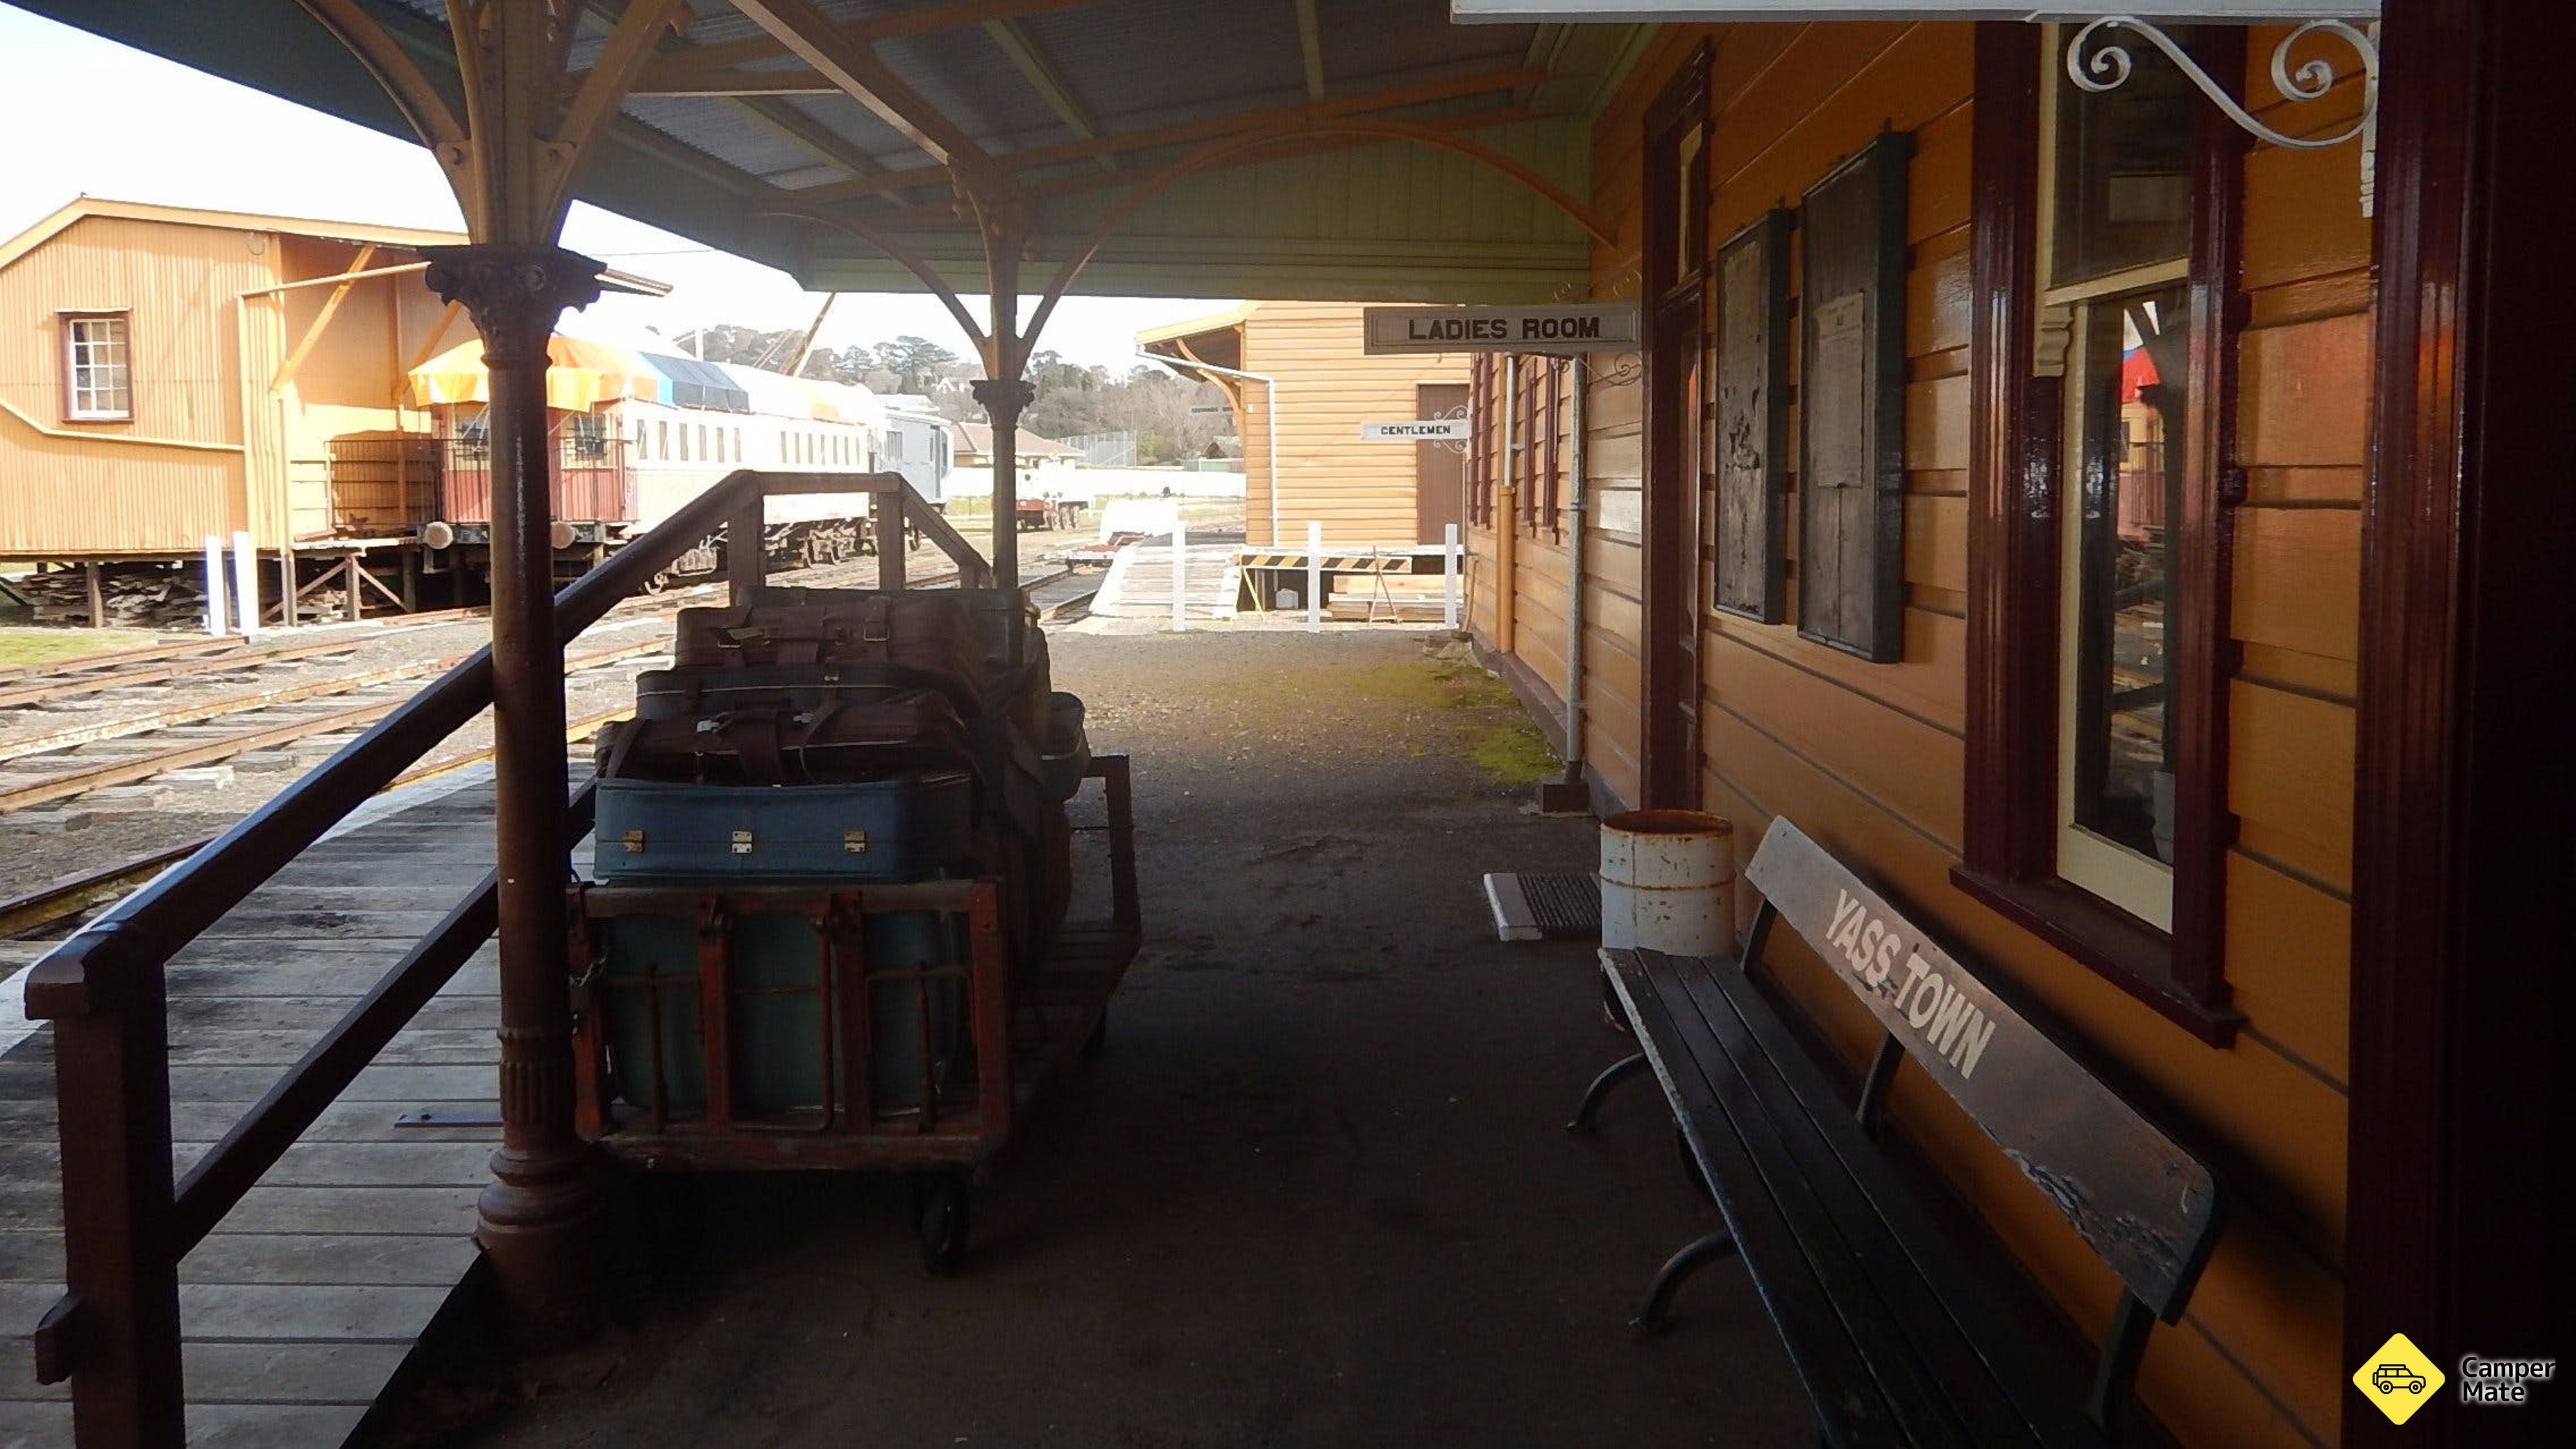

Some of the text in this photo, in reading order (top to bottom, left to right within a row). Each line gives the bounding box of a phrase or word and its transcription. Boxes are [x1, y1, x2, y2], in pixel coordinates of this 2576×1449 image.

[1409, 317, 1600, 339] LADIES ROOM
[1381, 426, 1451, 435] GENTLEMEN
[1826, 888, 1996, 1079] YASS TOWN
